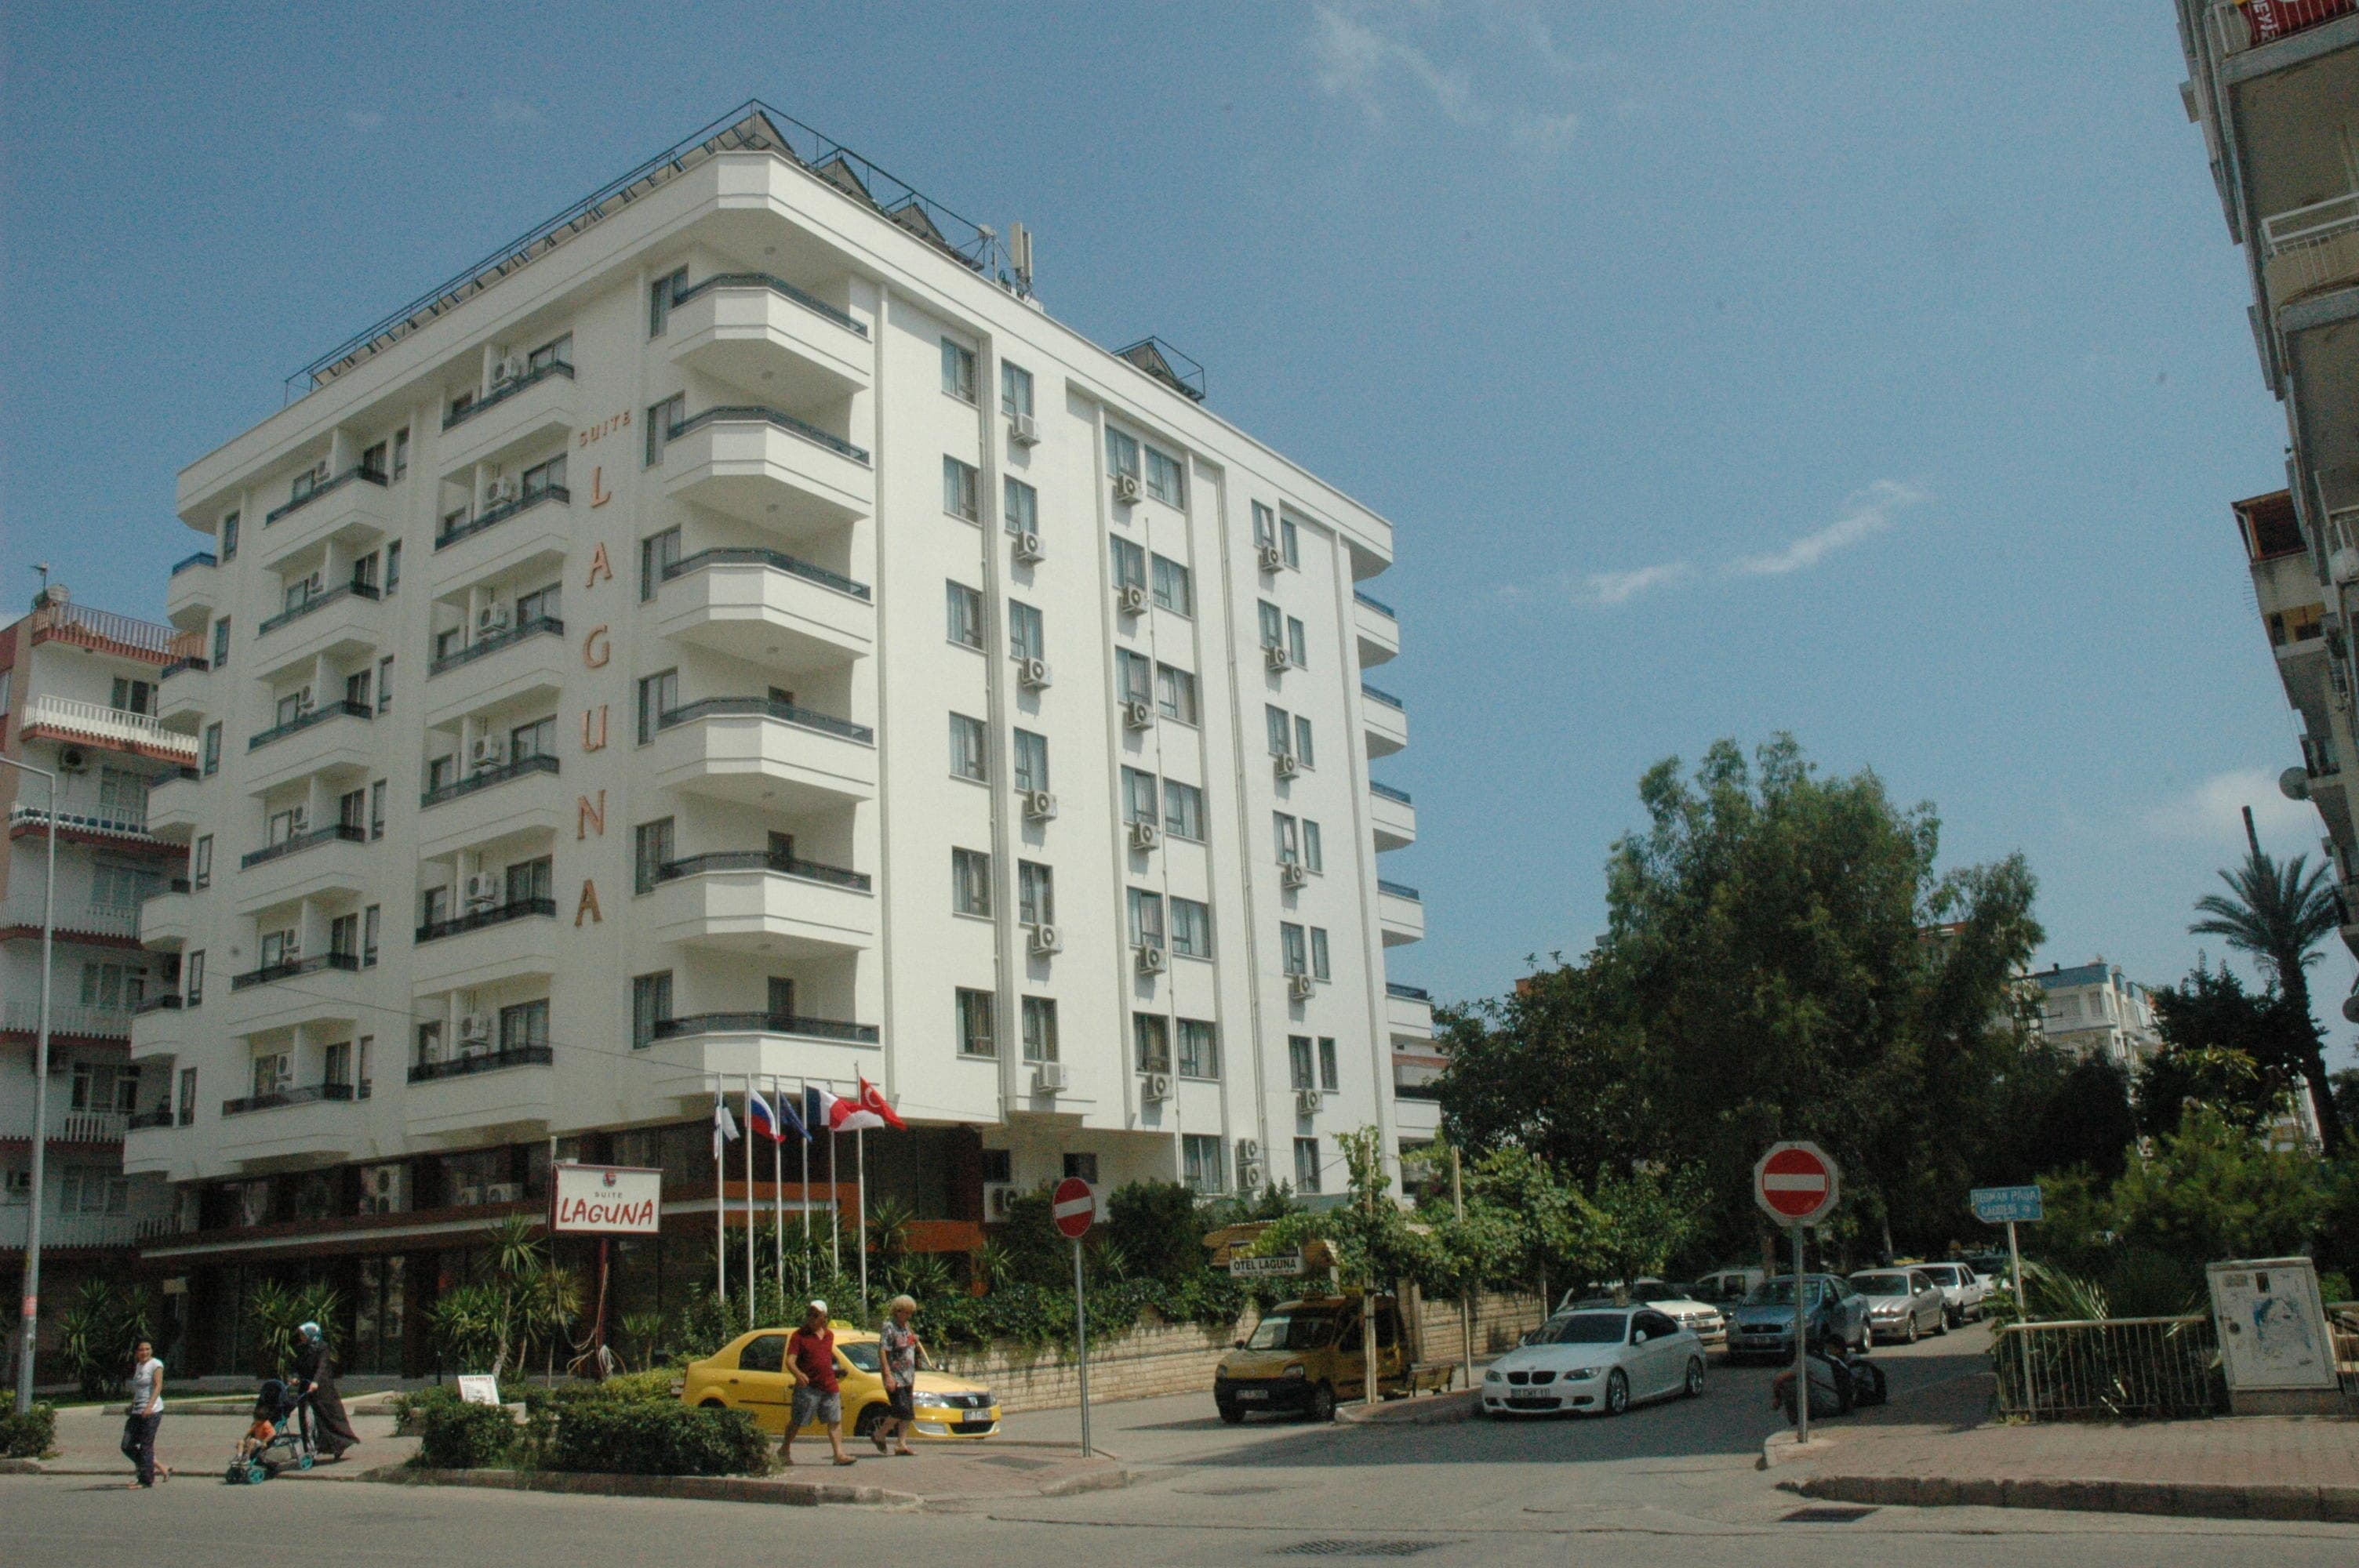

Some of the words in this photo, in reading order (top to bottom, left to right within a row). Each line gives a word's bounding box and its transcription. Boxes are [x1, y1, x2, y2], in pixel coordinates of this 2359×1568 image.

[580, 410, 631, 447] SUITE
[574, 466, 612, 928] LAGUNA
[560, 1197, 653, 1226] LAGUNA
[1234, 1260, 1256, 1271] OTEL
[1259, 1258, 1296, 1269] LAGUNA
